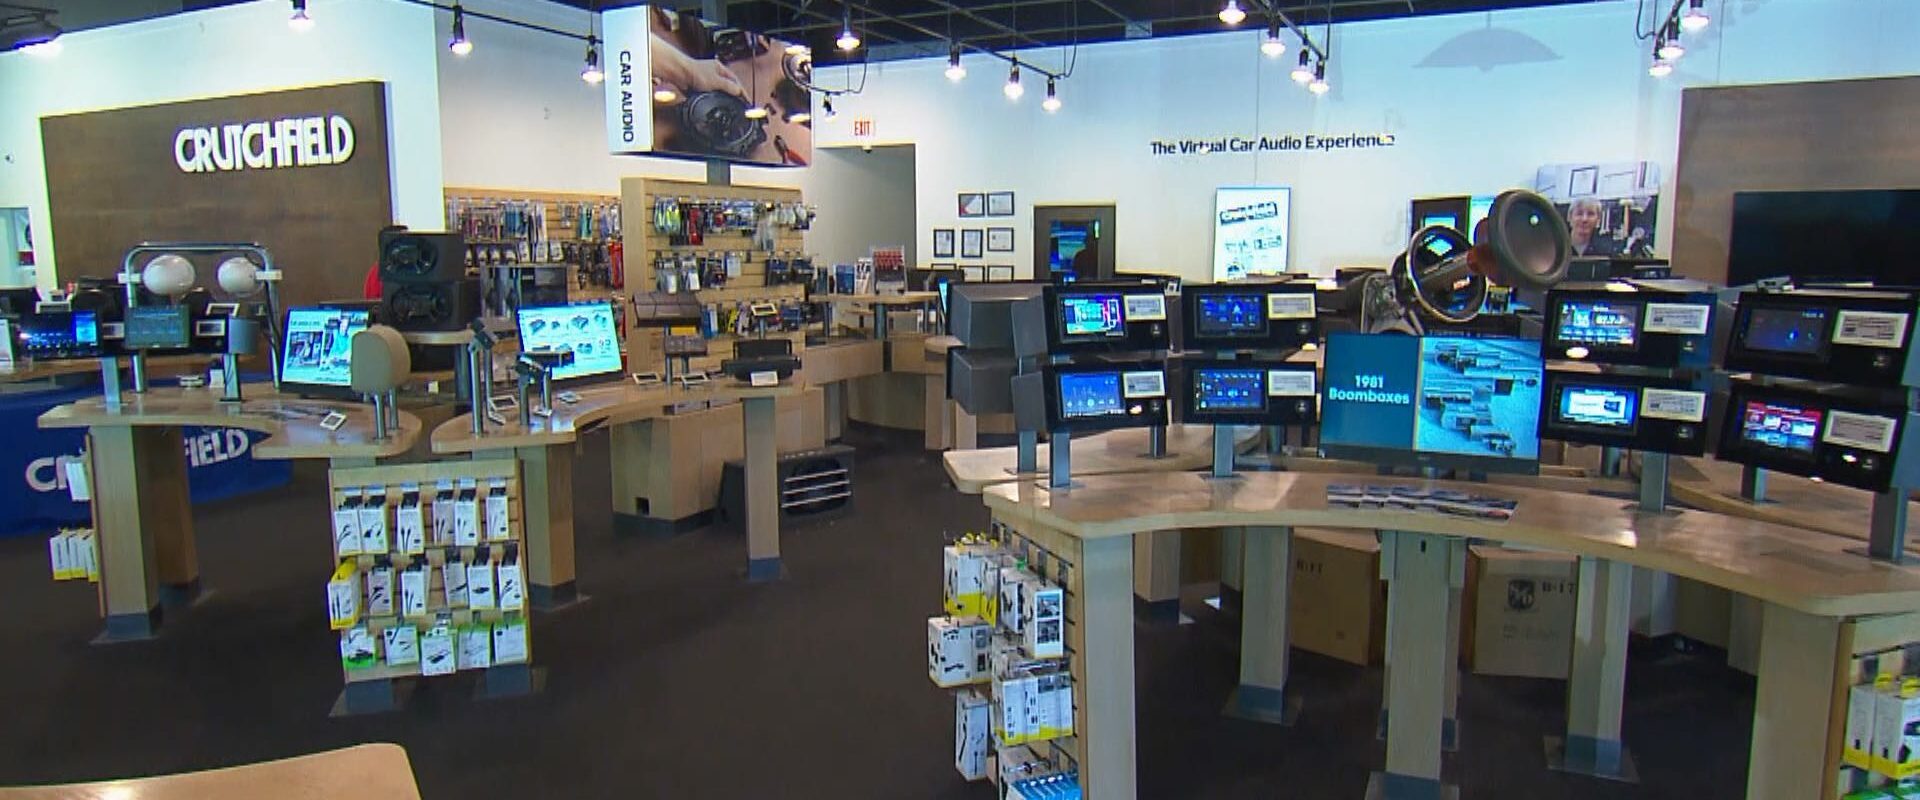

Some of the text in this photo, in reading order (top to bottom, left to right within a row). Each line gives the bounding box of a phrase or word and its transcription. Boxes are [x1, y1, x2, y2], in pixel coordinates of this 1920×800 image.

[620, 51, 634, 142] CAR AUDIO
[853, 120, 870, 136] EXIT
[175, 115, 355, 173] CRUTCHFIELD
[1150, 141, 1176, 155] The
[1230, 137, 1255, 152] Car
[1258, 136, 1302, 151] Audio
[1354, 374, 1384, 388] 1981
[1328, 387, 1410, 404] Boomboxes
